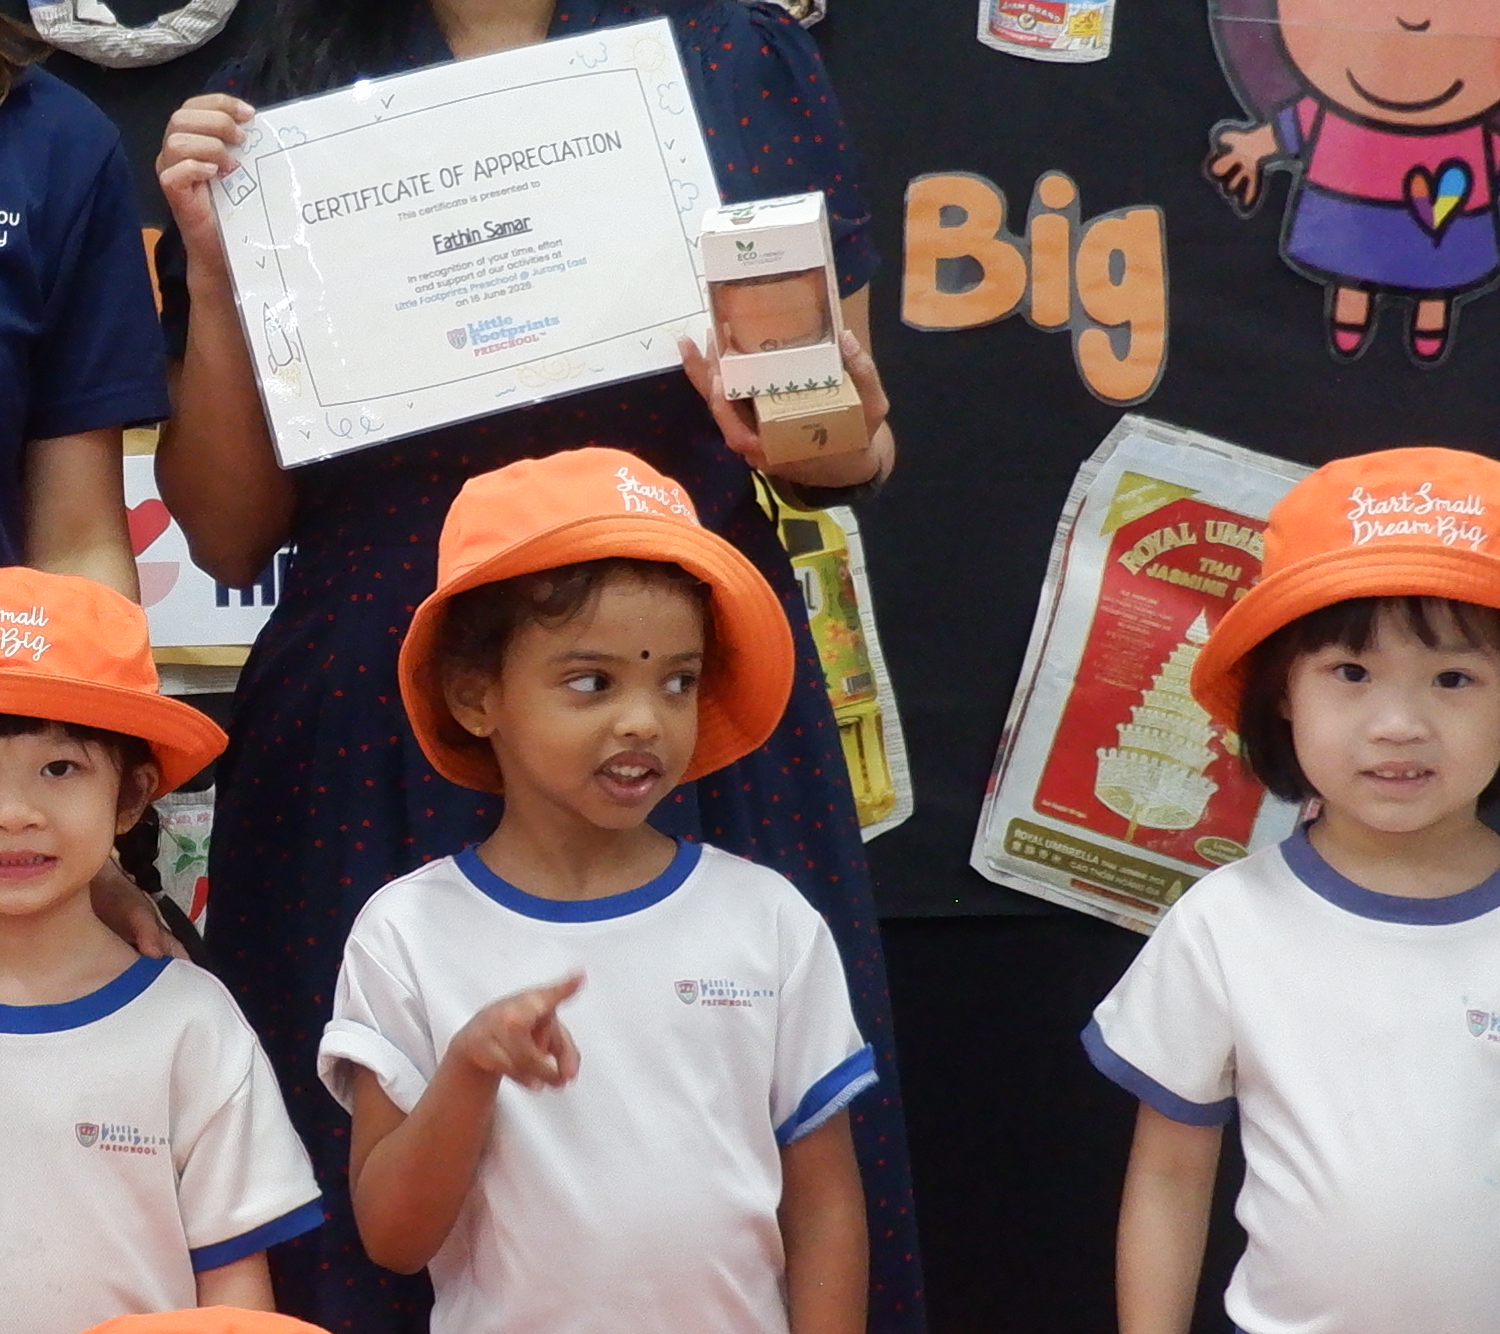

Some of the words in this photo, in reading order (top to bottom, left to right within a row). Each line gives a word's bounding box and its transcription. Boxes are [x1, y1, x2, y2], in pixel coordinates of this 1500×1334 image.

[301, 172, 435, 225] CERTIFICATE
[439, 164, 465, 190] OF
[473, 130, 624, 183] APPRECIATION
[736, 251, 758, 262] ECO
[414, 281, 435, 294] and
[454, 298, 469, 309] on
[482, 287, 507, 301] June
[901, 174, 1166, 402] Big
[466, 315, 514, 334] Little
[470, 316, 561, 347] Footprints
[615, 466, 671, 505] Start
[1347, 485, 1416, 523] Start
[1413, 482, 1484, 518] Small
[1352, 518, 1431, 548] Dream
[1432, 516, 1488, 549] Big
[1117, 522, 1198, 577] ROYAL
[1199, 556, 1243, 582] THAI
[0, 628, 51, 662] Big
